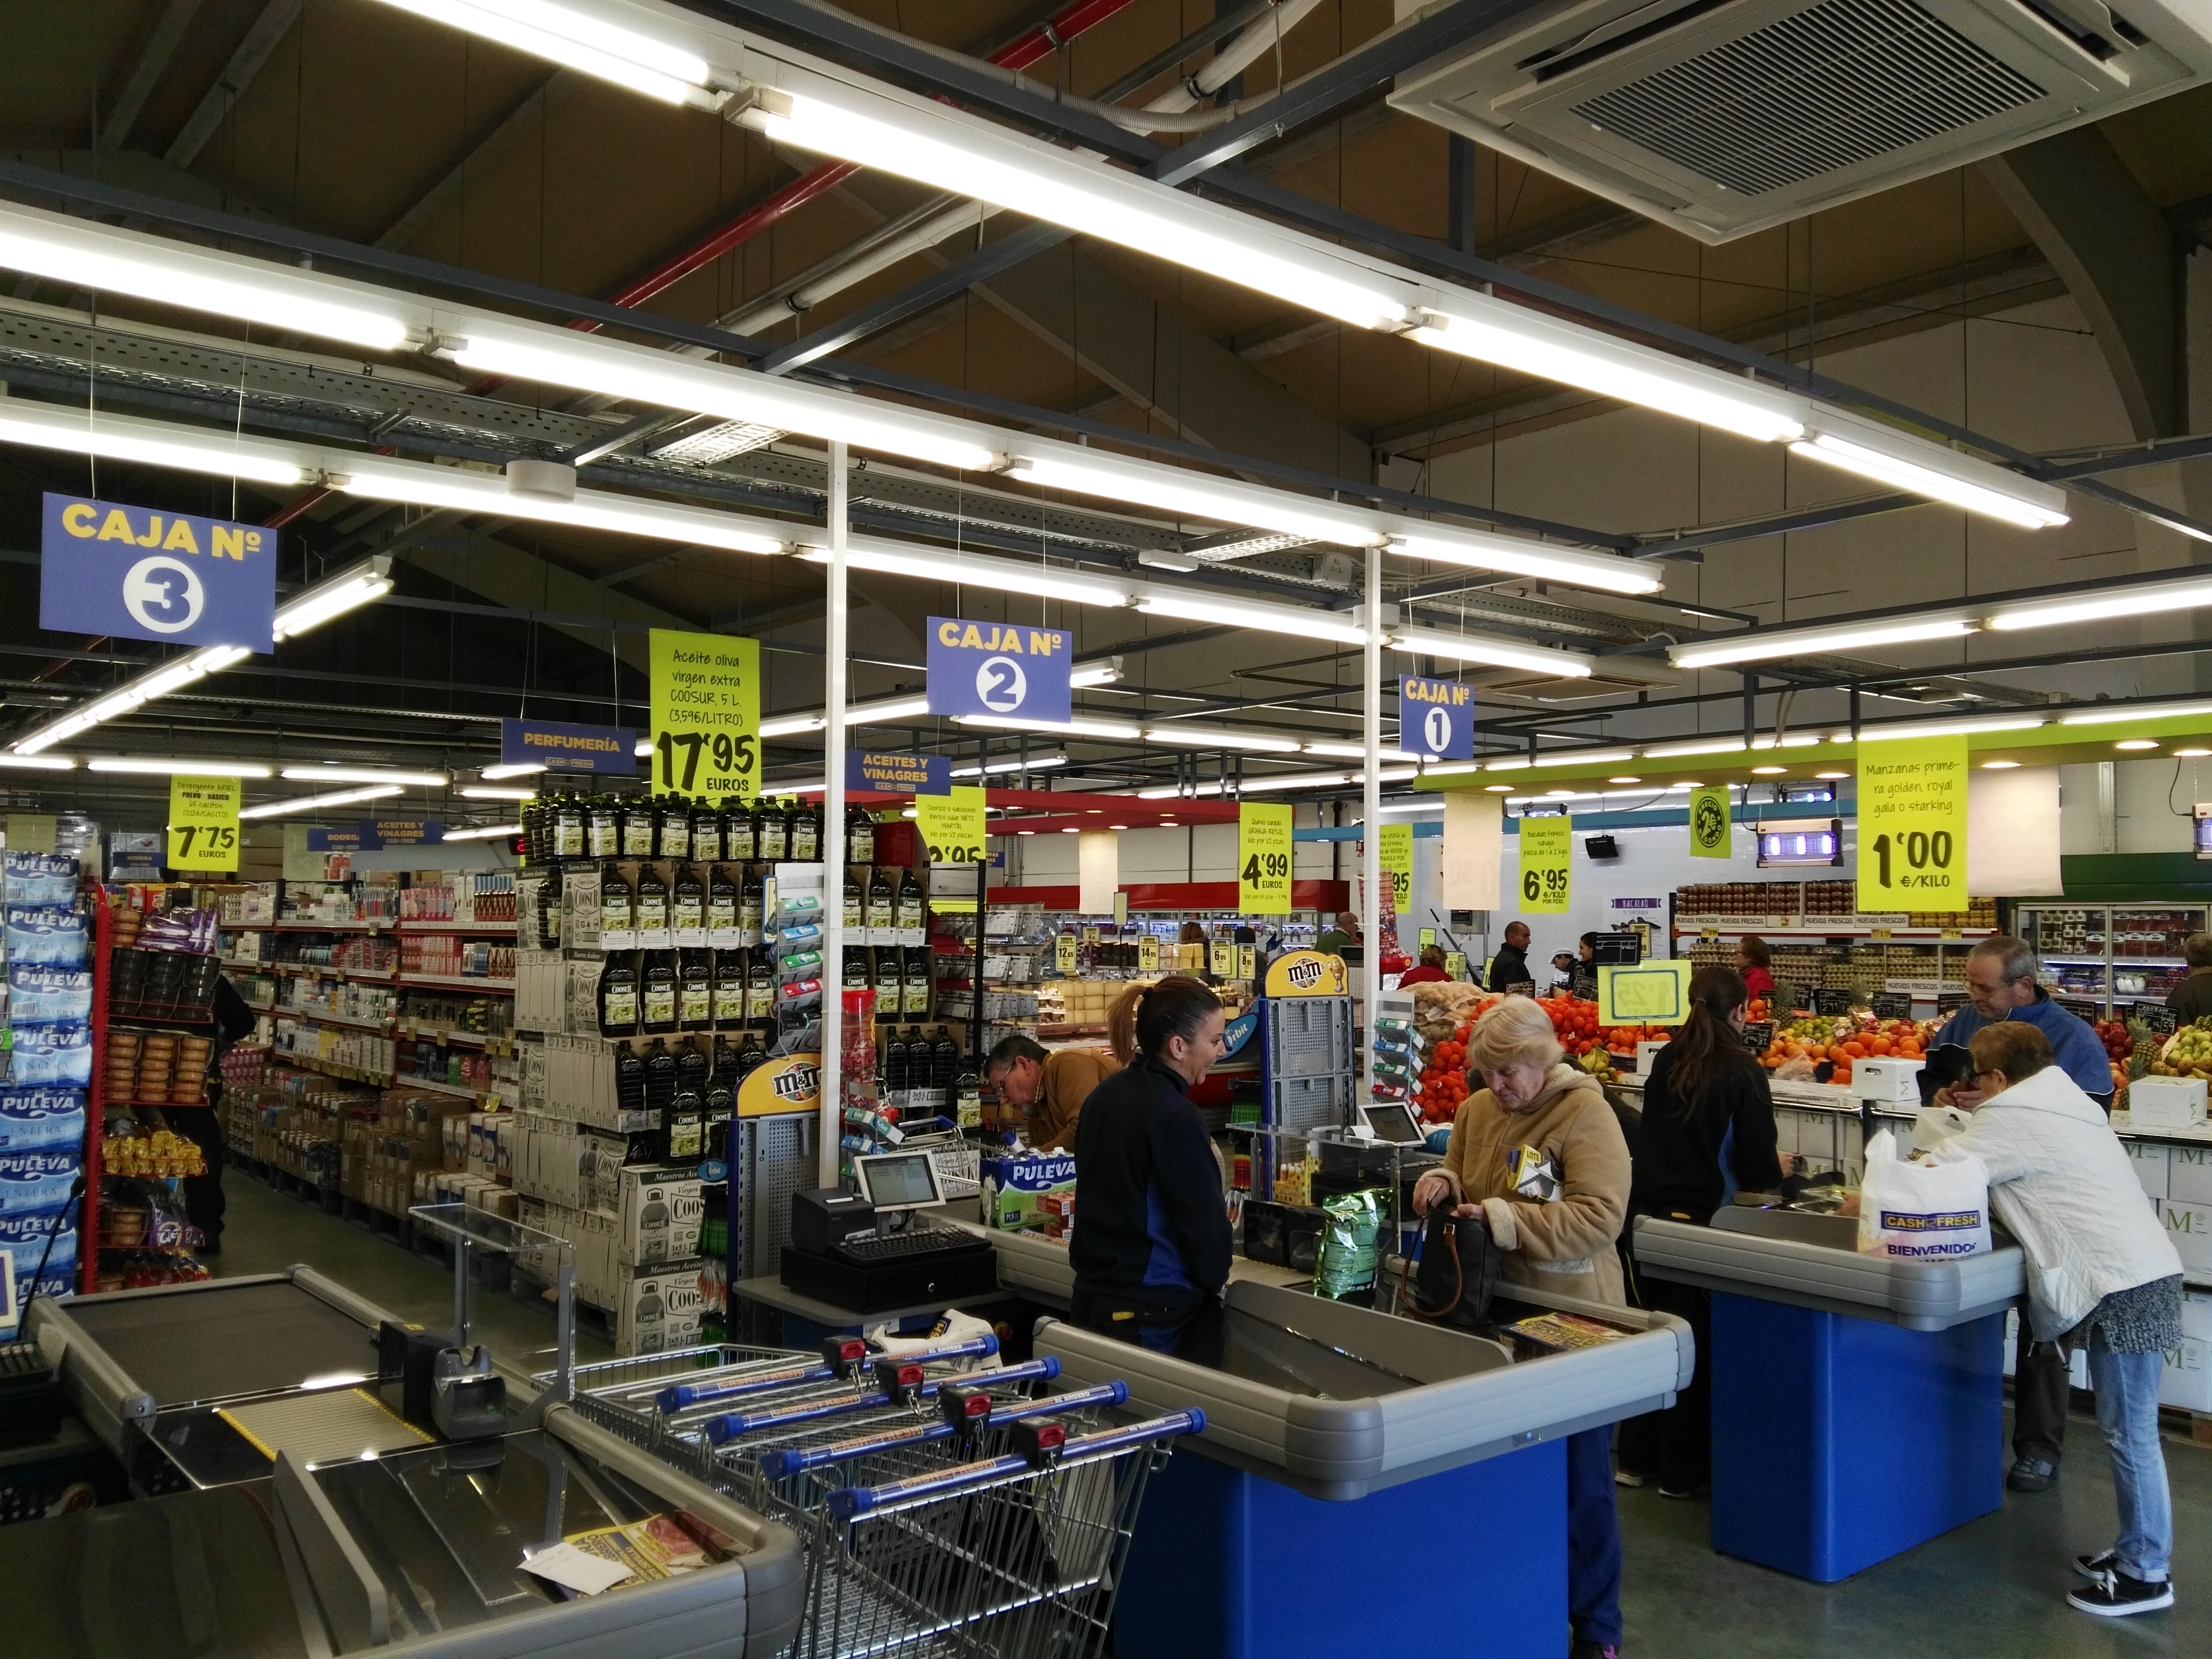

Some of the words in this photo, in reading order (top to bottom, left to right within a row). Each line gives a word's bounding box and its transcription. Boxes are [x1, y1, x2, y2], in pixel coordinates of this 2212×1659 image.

[62, 503, 199, 555] CAJA
[212, 525, 261, 561] Nº
[141, 567, 191, 624] 3
[939, 622, 1023, 654] CAJA
[1030, 631, 1062, 657] Nº
[673, 649, 711, 664] Aceite
[715, 653, 739, 668] oliva
[672, 670, 706, 688] virgen
[710, 674, 740, 687] extra
[985, 662, 1017, 705] 2
[671, 690, 717, 706] COOSUR,
[722, 693, 728, 705] 5
[1405, 680, 1449, 703] CAJA
[1431, 713, 1443, 747] 1
[524, 733, 621, 752] PERFUMERÍA
[863, 754, 917, 768] ACEITES
[919, 758, 929, 769] Y
[863, 768, 928, 782] VINAGRES
[1866, 764, 1921, 776] Manzanas
[178, 782, 215, 791] Detergente
[706, 777, 749, 792] EUROS
[1874, 785, 1884, 794] ra
[1927, 780, 1953, 795] royal
[1698, 801, 1717, 814] PRECIO
[1874, 802, 1895, 818] gala
[1899, 803, 1905, 811] o
[1909, 800, 1953, 815] starking
[5, 858, 70, 873] PULEVA
[1900, 875, 1950, 887] €/KILO
[643, 898, 663, 906] COOSUR
[1623, 899, 1648, 908] BACALAO
[11, 911, 79, 927] PULEVA
[16, 972, 89, 986] PULEVA
[12, 1033, 82, 1045] PULEVA
[1225, 1024, 1249, 1047] Orbit
[2, 1096, 75, 1110] PULEVA
[678, 1116, 698, 1125] COOSUR
[1527, 1151, 1539, 1161] LOTE
[0, 1156, 70, 1172] PULEVA
[1013, 1161, 1076, 1180] PULEVA
[655, 1171, 685, 1182] Maestros
[678, 1186, 698, 1195] Virgen
[1887, 1216, 1925, 1228] CASH
[1937, 1216, 1977, 1227] FRESH
[649, 1264, 680, 1275] Maestros
[937, 1344, 962, 1352] AHORRO
